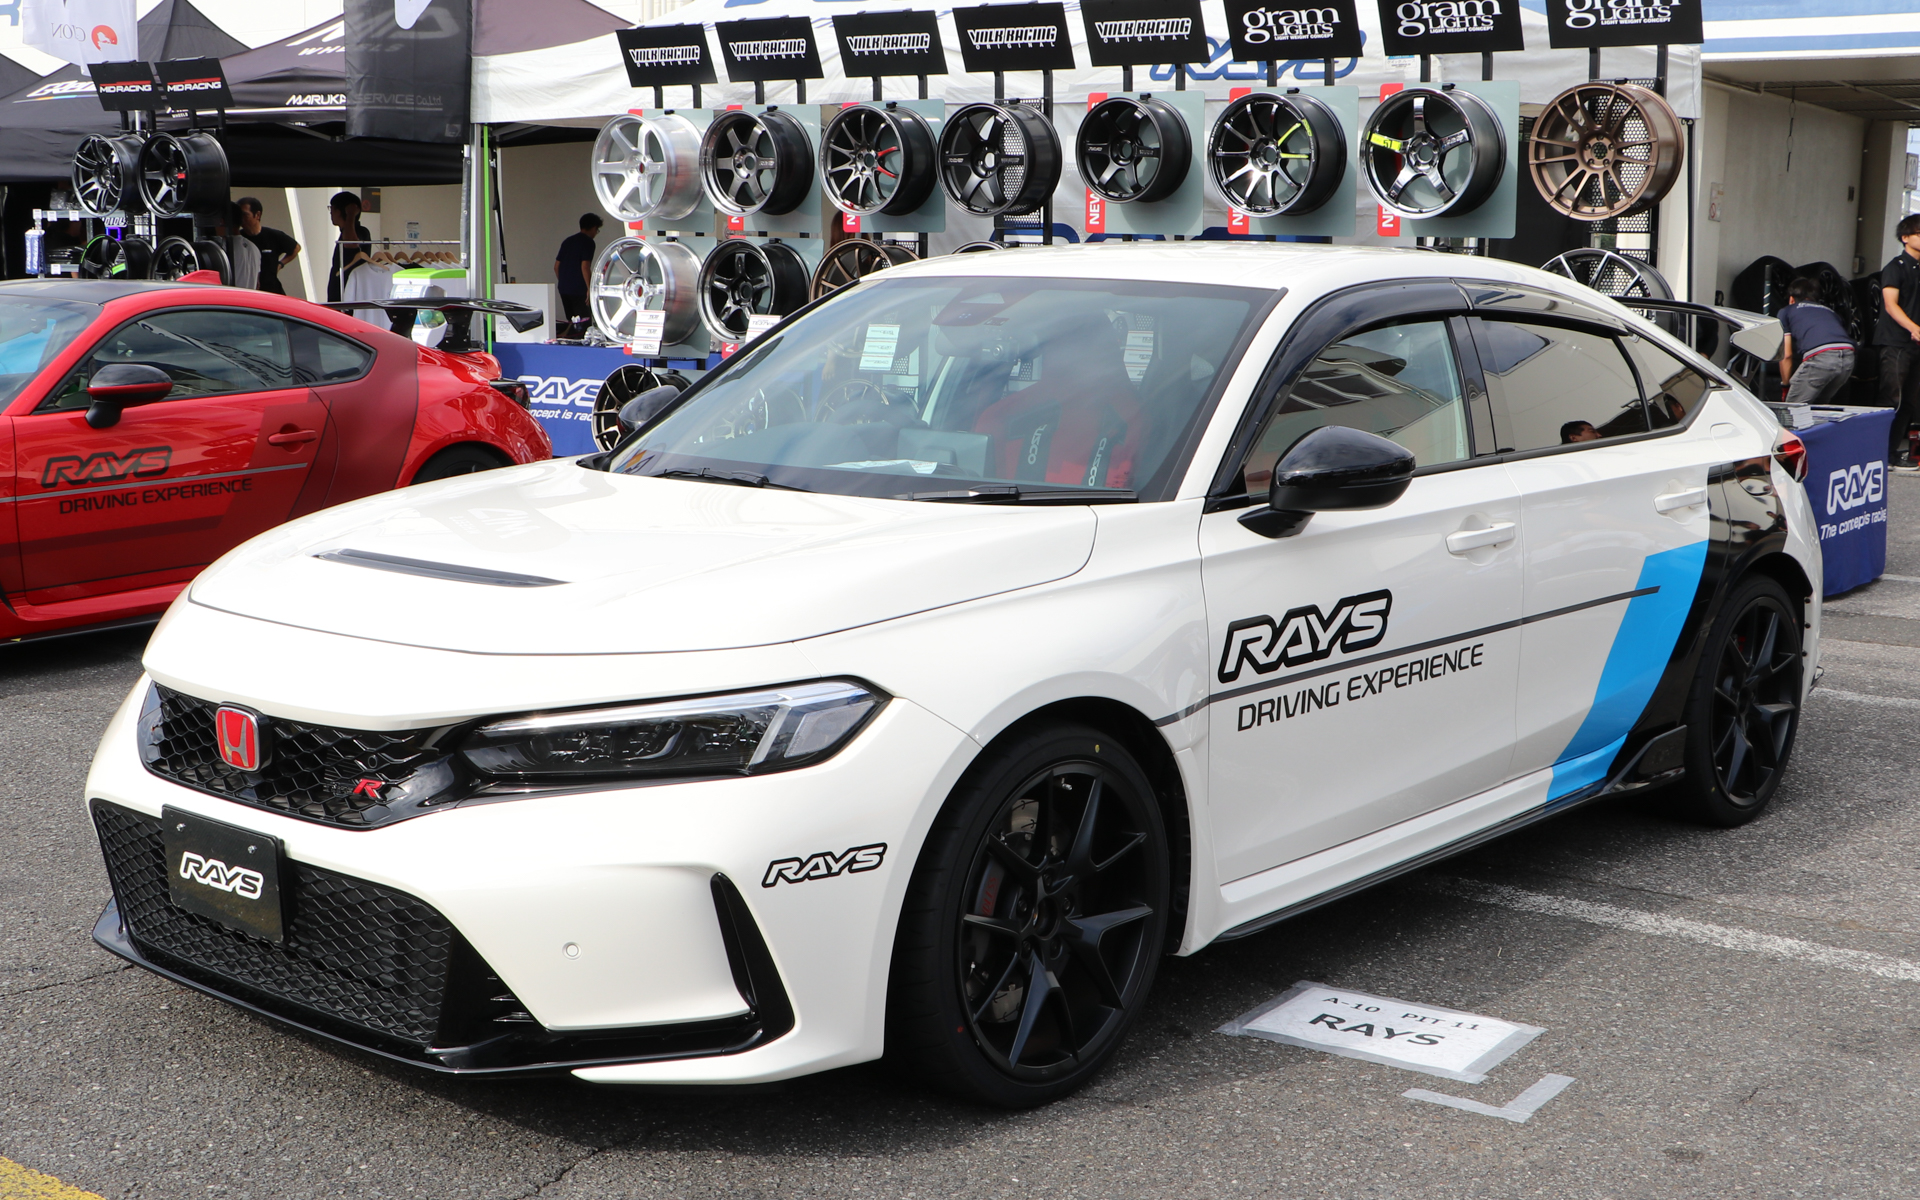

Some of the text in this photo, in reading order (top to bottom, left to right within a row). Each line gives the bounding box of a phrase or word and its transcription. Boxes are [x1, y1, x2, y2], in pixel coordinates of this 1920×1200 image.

[1396, 0, 1502, 38] gram
[1428, 14, 1494, 29] LIGHTS
[1600, 5, 1672, 21] LIGHTS
[967, 25, 1058, 46] VOLK RACING
[1095, 17, 1192, 38] VOLK RACING
[1242, 7, 1341, 44] gram
[1272, 23, 1334, 35] LIGHTS
[729, 38, 806, 57] VOLK RACING
[846, 33, 931, 52] VOLK RACING
[976, 42, 1056, 50] ORIGINAL
[1103, 34, 1189, 43] ORIGINAL
[629, 45, 700, 63] VOLK RACING
[737, 53, 805, 61] ORIGINAL
[854, 48, 929, 56] ORIGINAL
[636, 60, 699, 68] ORIGINAL
[100, 85, 115, 94] MID
[117, 84, 152, 93] RACING
[167, 81, 221, 93] MID RACING
[517, 375, 605, 408] RAYS
[529, 408, 593, 421] ncept is rac
[1027, 424, 1048, 464] USCO
[41, 445, 172, 488] RAYS
[1088, 437, 1107, 486] CUSCO
[59, 478, 253, 514] DRIVING EXPERIENCE
[1826, 460, 1884, 515] RAYS
[1820, 523, 1837, 540] The
[1217, 588, 1392, 684] RAYS
[1237, 643, 1484, 732] DRIVING EXPERIENCE
[180, 851, 264, 900] RAYS
[761, 842, 888, 888] RAYS
[1322, 996, 1479, 1031] A-10 PIT 11
[1308, 1013, 1446, 1046] RAYS
